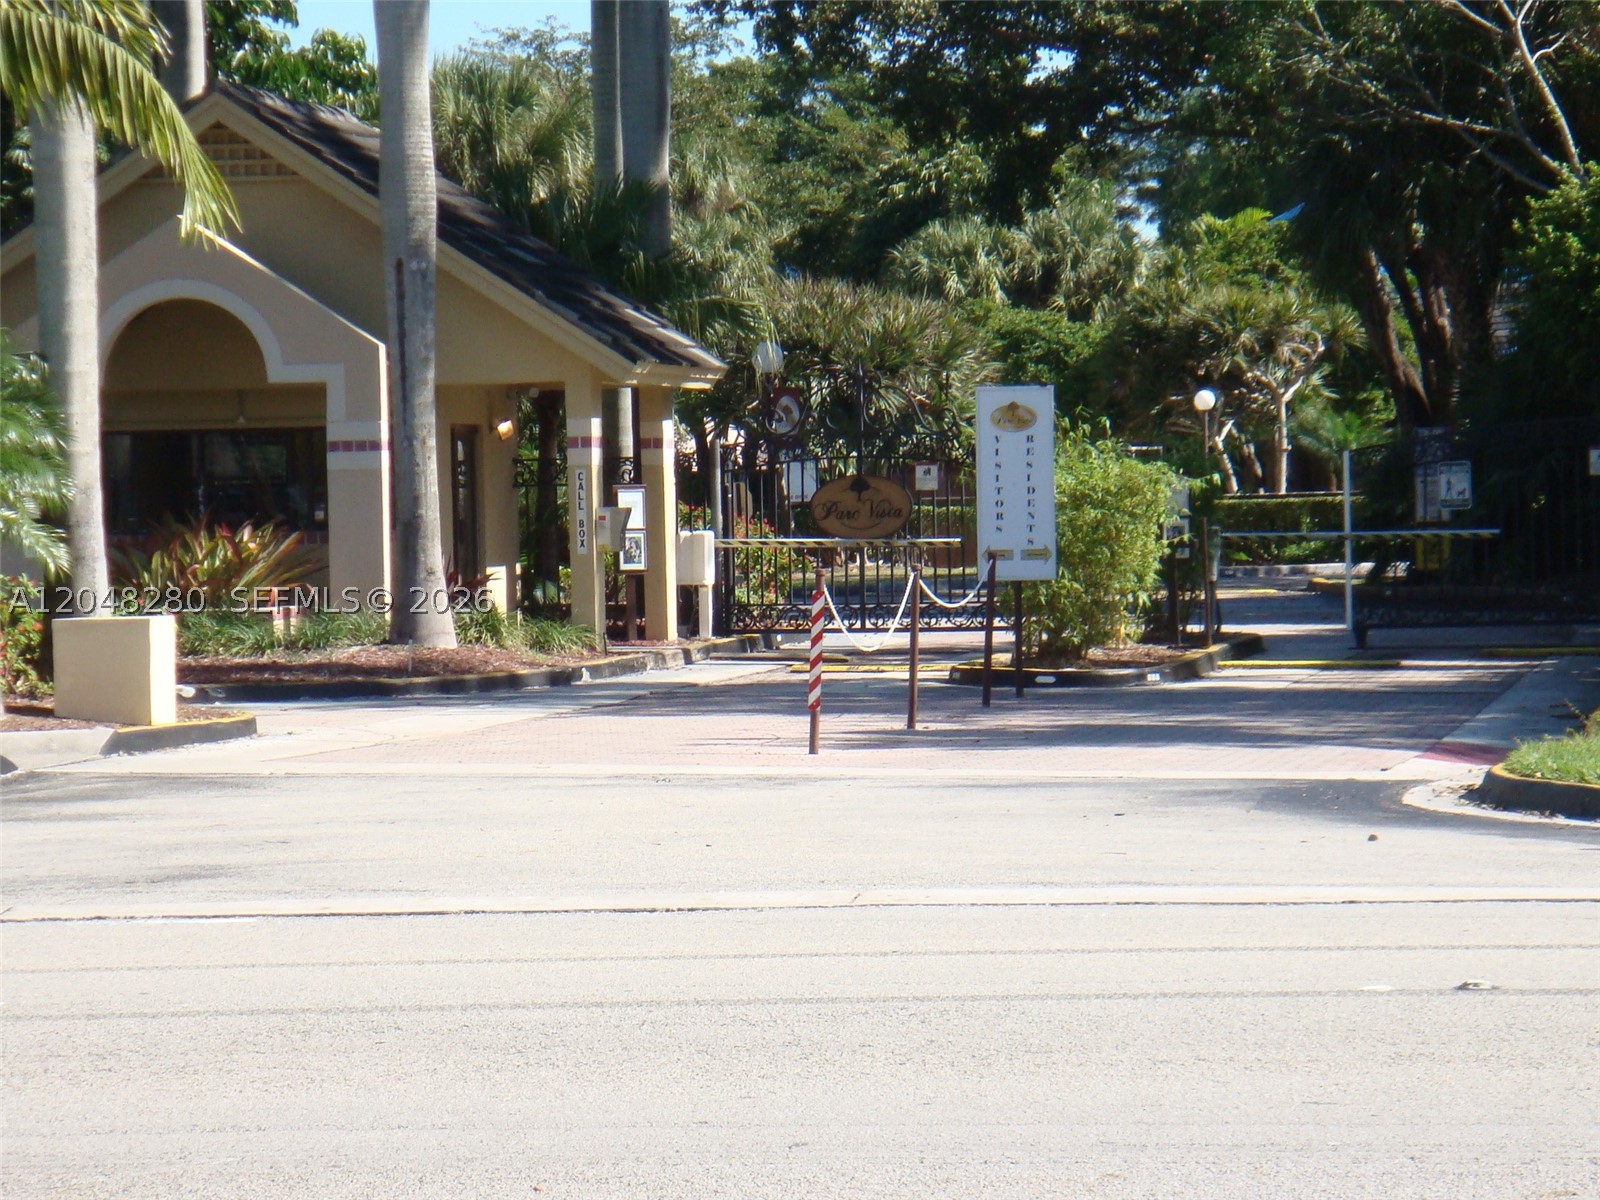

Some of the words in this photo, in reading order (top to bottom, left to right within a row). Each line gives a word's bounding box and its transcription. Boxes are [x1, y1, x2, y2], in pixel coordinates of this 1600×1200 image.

[818, 501, 859, 520] Parc
[864, 500, 904, 519] Vista
[994, 435, 1004, 533] VISITORS
[1026, 435, 1036, 546] RESIDENTS
[578, 520, 586, 549] BOX
